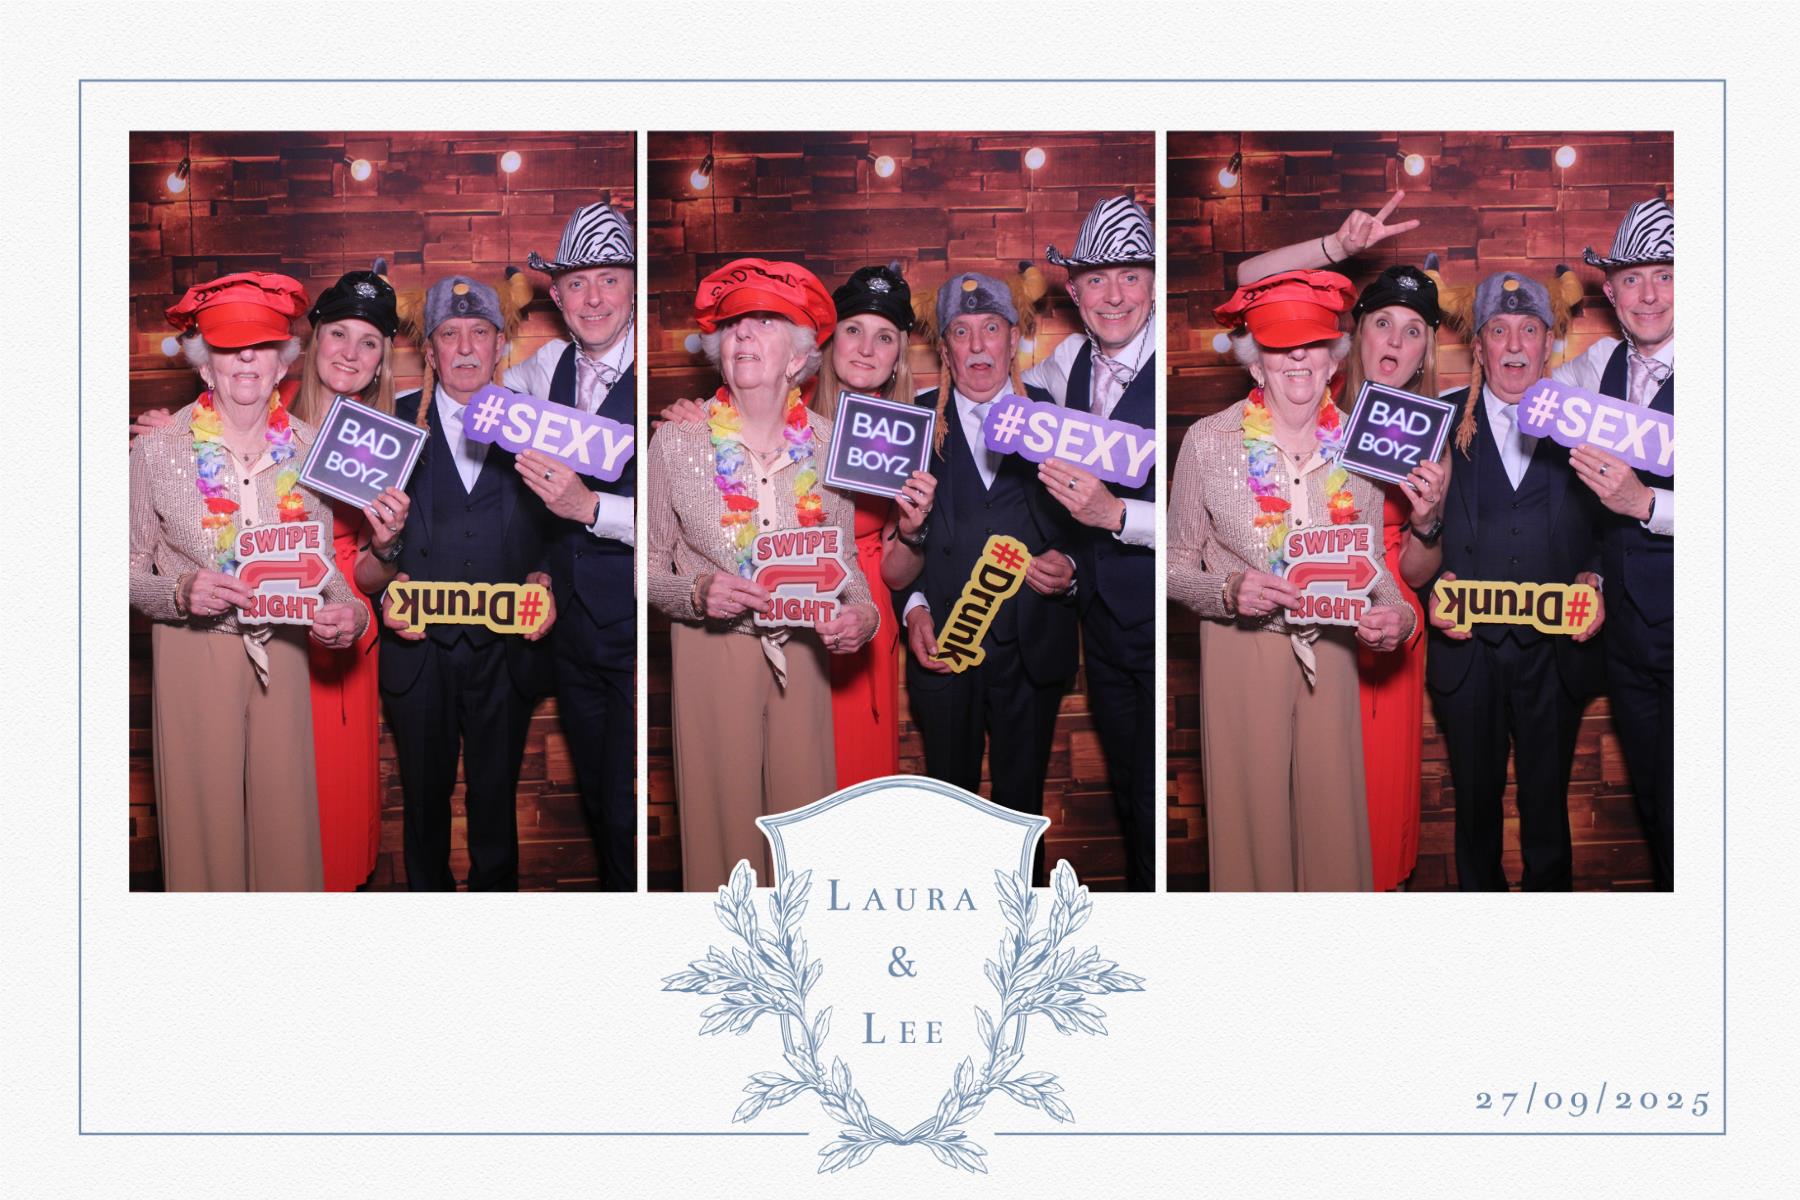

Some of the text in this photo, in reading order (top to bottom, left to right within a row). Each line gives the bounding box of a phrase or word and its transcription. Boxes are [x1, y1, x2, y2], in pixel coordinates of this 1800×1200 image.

[472, 394, 635, 472] #SEXY
[852, 412, 916, 446] BAD
[1368, 400, 1431, 436] BAD
[337, 418, 401, 460] BAD
[993, 404, 1156, 477] #SEXY
[1358, 432, 1421, 465] BOYZ
[324, 450, 389, 490] BOYZ
[847, 446, 910, 477] BOYZ
[240, 525, 320, 557] SWIPE
[757, 530, 838, 561] SWIPE
[1288, 527, 1369, 558] SWIPE
[396, 588, 544, 626] #Drunk
[936, 542, 1025, 666] #Drunk
[1442, 587, 1592, 627] #Drunk
